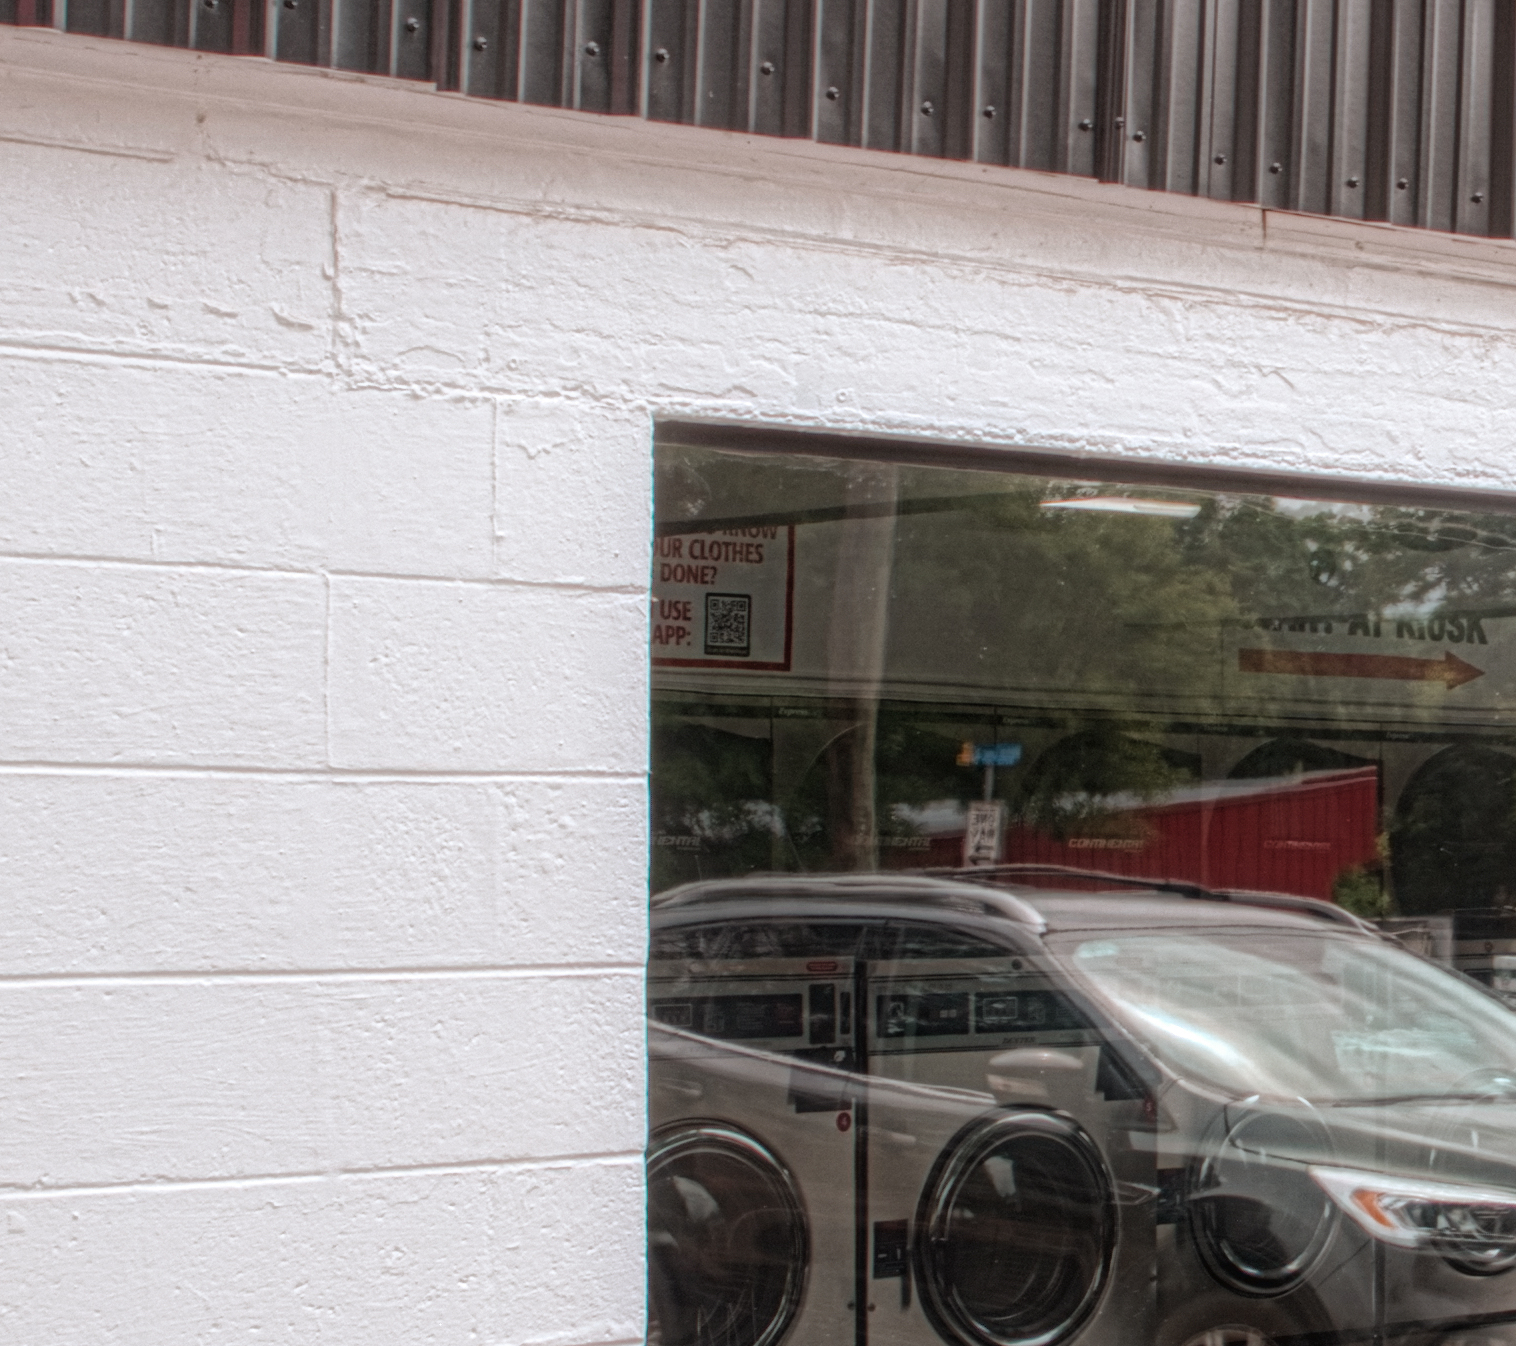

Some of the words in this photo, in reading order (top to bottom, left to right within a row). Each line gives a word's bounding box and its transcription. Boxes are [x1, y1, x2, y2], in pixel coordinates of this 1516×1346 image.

[688, 539, 765, 564] CLOTHES
[659, 562, 718, 585] DONE?
[659, 599, 693, 621] USE
[652, 624, 692, 646] APP:
